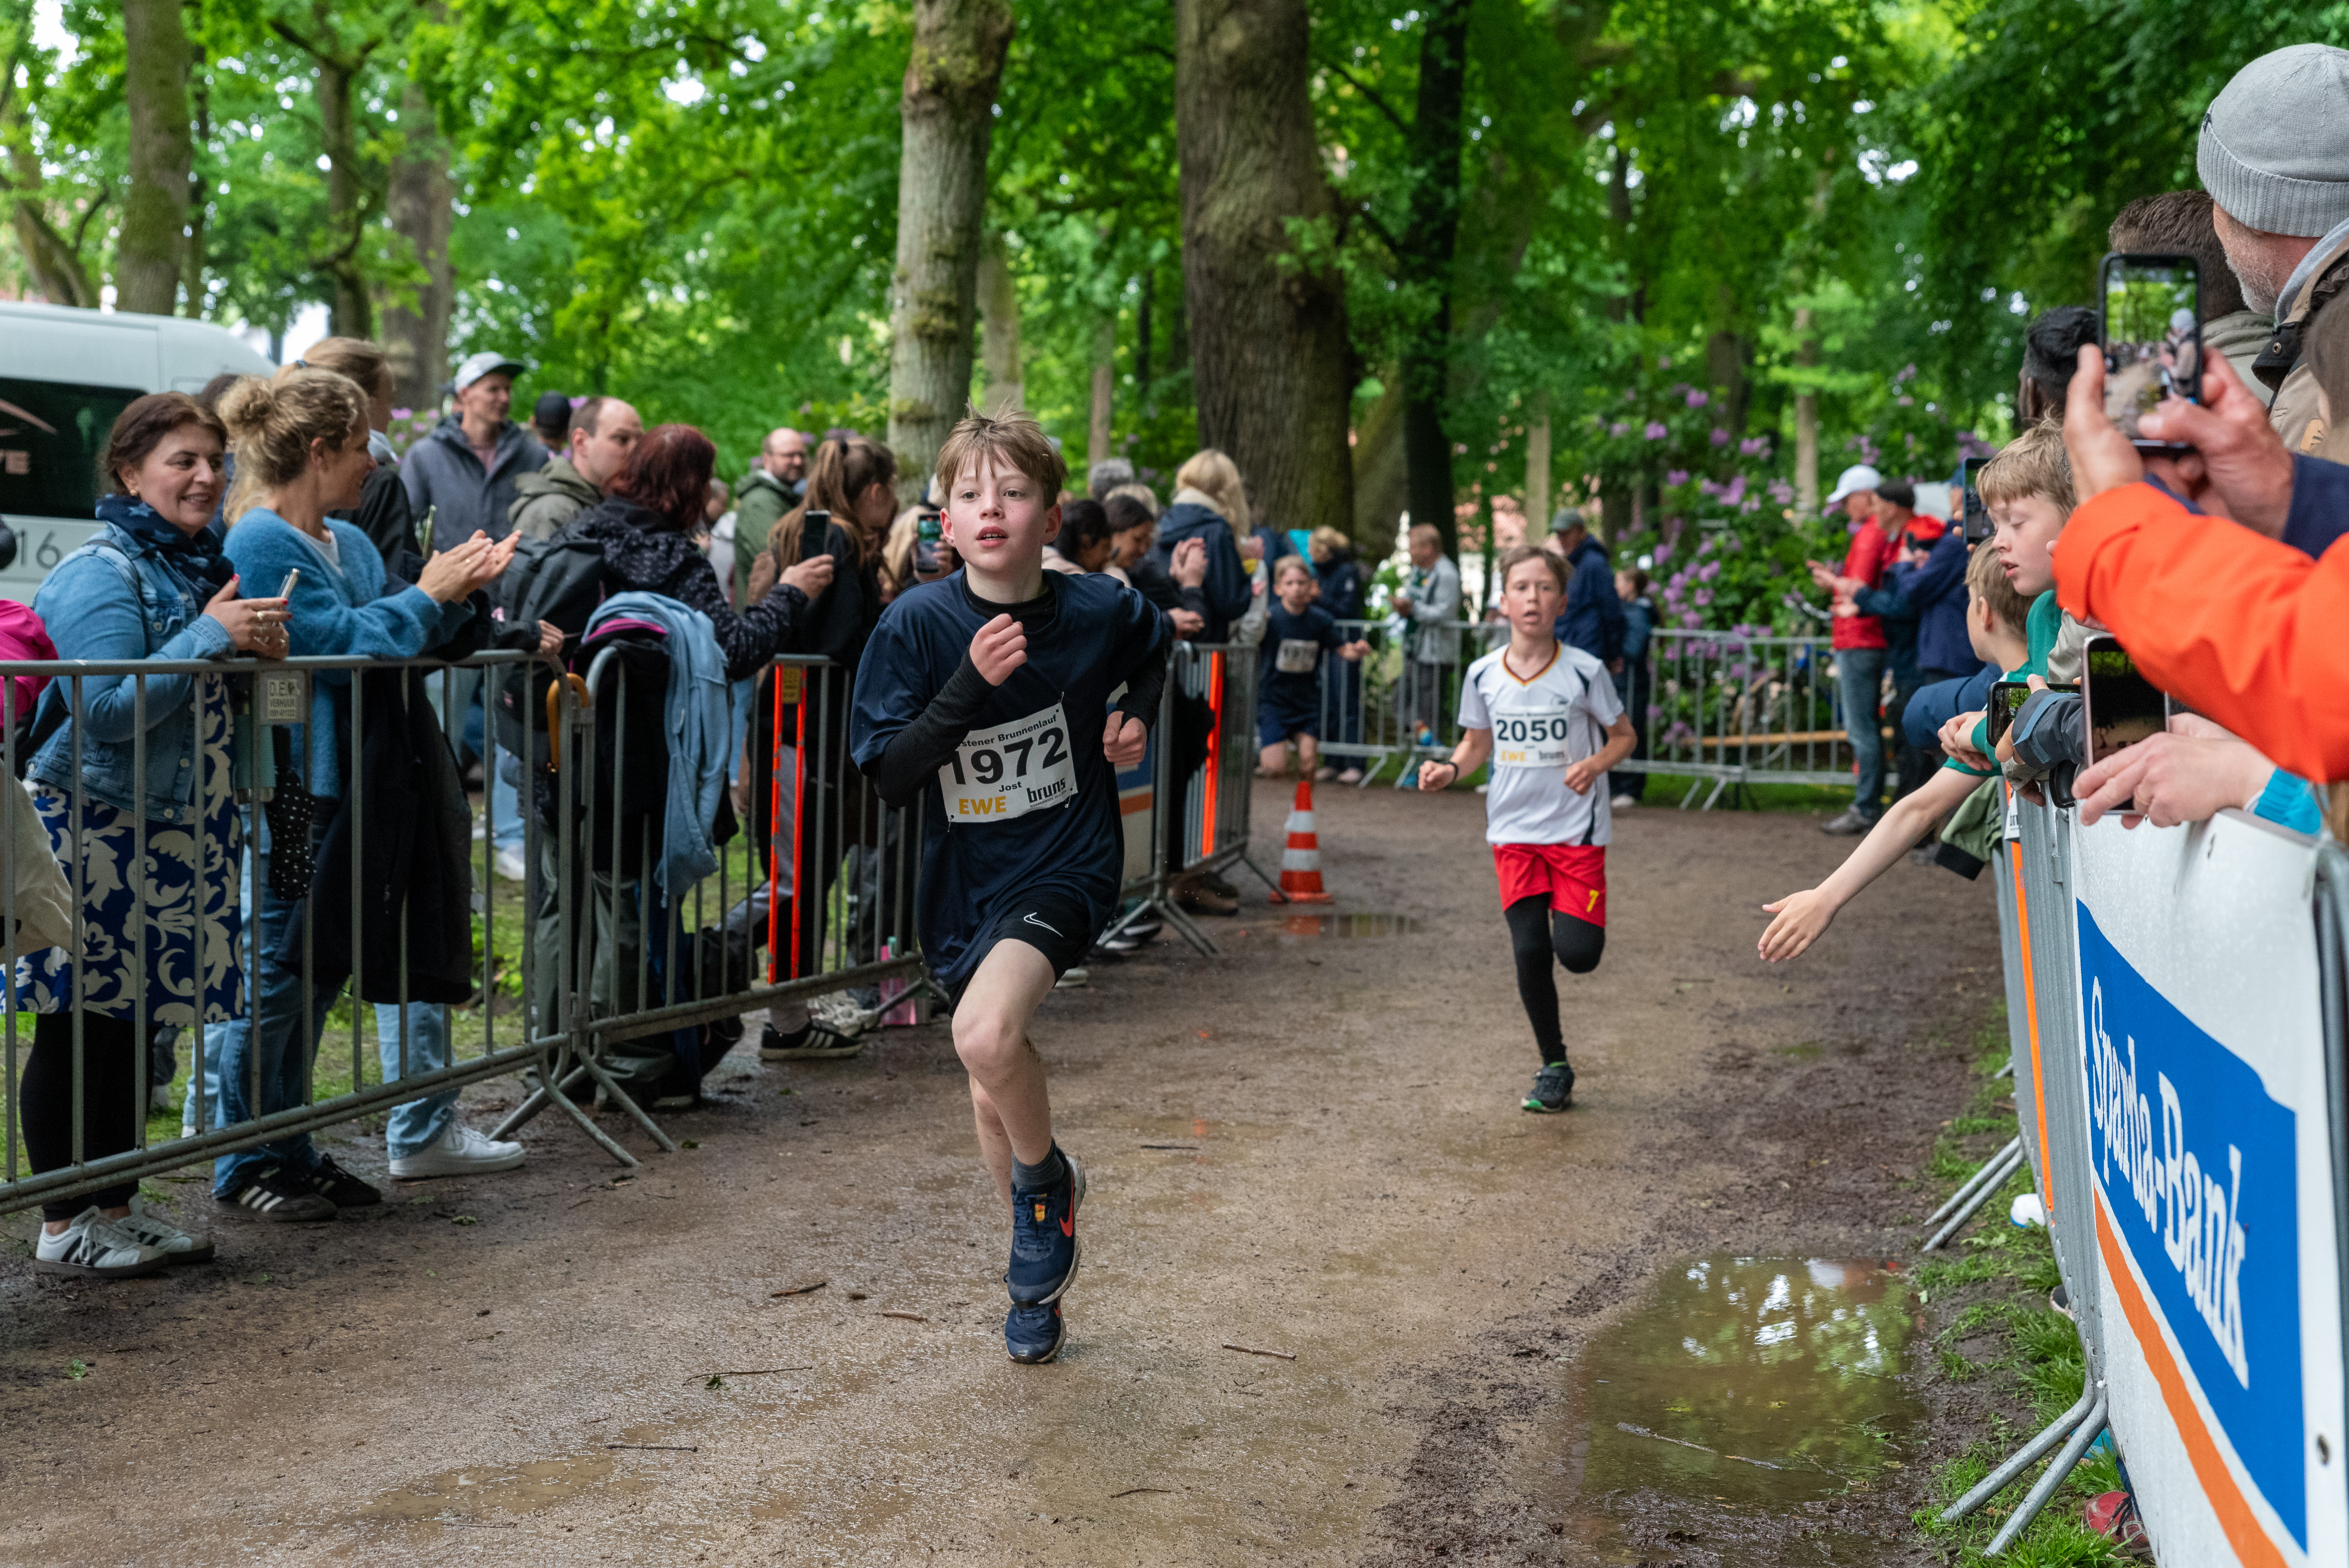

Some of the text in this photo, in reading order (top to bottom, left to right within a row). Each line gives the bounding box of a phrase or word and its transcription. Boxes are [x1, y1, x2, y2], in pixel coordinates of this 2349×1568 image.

[998, 714, 1057, 742] Brunnenlauf
[1496, 718, 1567, 742] 2050
[943, 727, 1068, 785] 1972
[958, 778, 1066, 815] EWE bruns
[999, 781, 1022, 792] Jost
[2092, 976, 2249, 1390] Sparda-Bank
